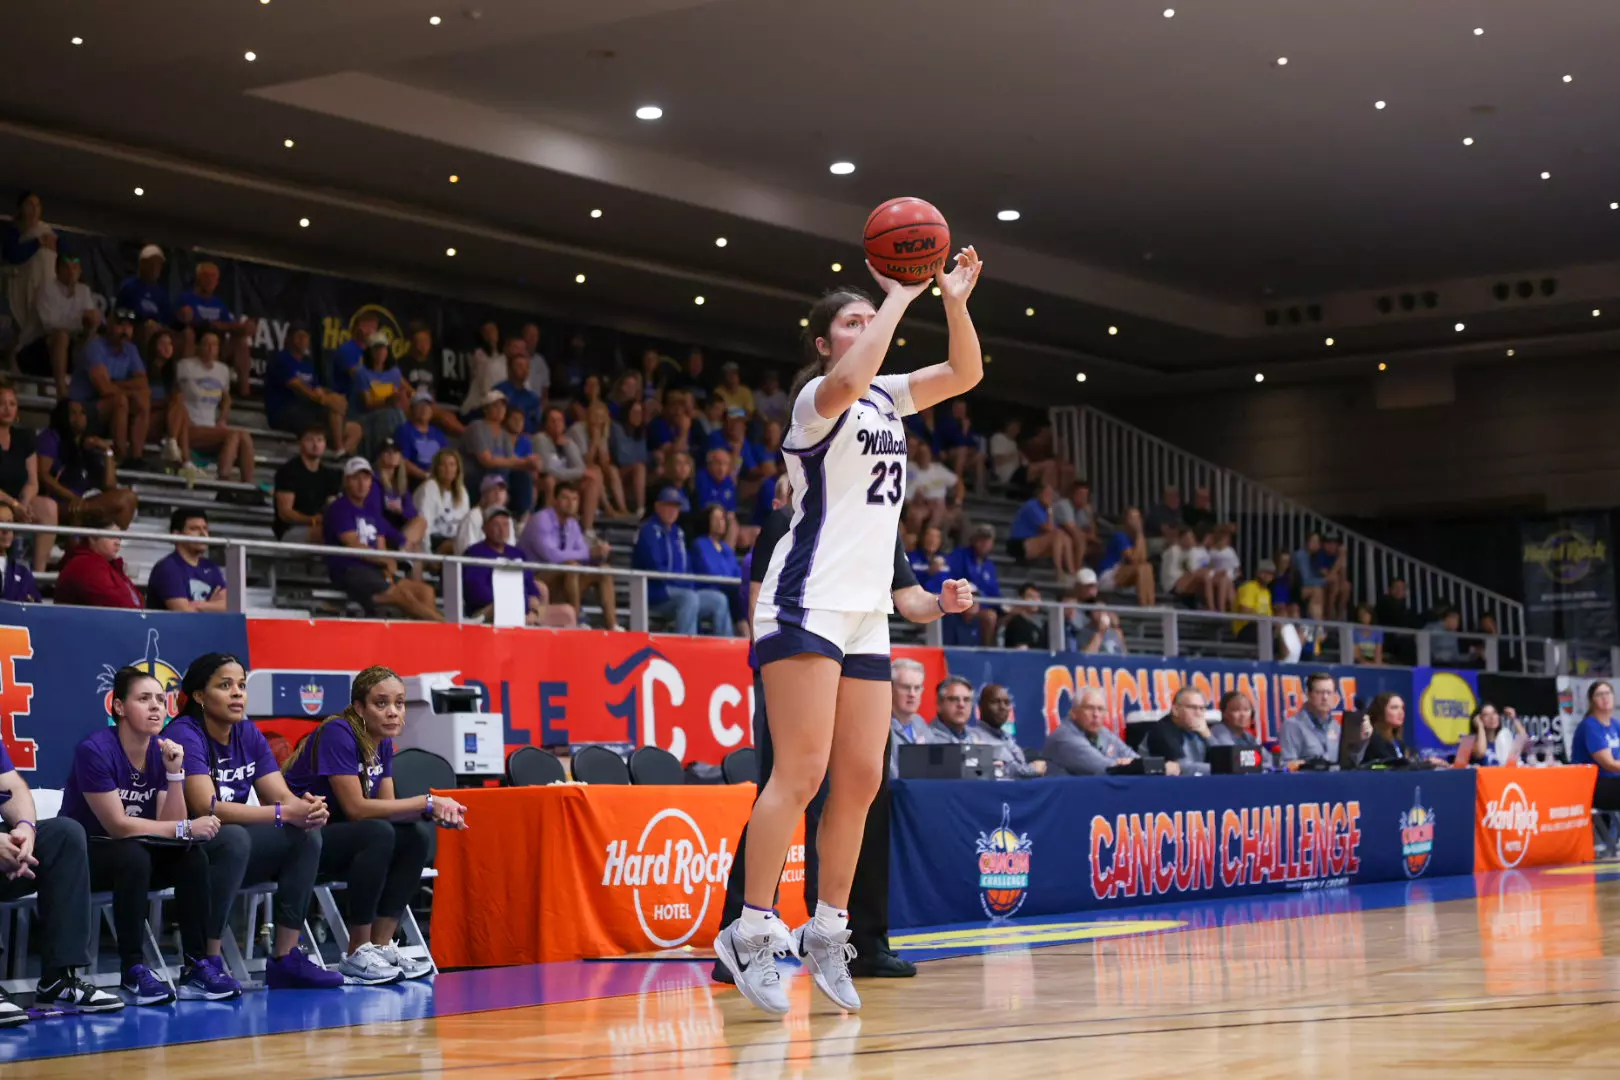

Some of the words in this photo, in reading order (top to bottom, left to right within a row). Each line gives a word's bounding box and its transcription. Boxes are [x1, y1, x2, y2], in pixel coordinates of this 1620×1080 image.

[893, 236, 937, 254] NCAA
[866, 460, 903, 507] 23
[601, 839, 673, 886] Hard
[673, 838, 734, 894] Rock
[978, 851, 1031, 875] CANCUN
[1089, 809, 1216, 900] CANCUN
[1220, 800, 1361, 888] CHALLENGE
[653, 903, 692, 920] HOTEL
